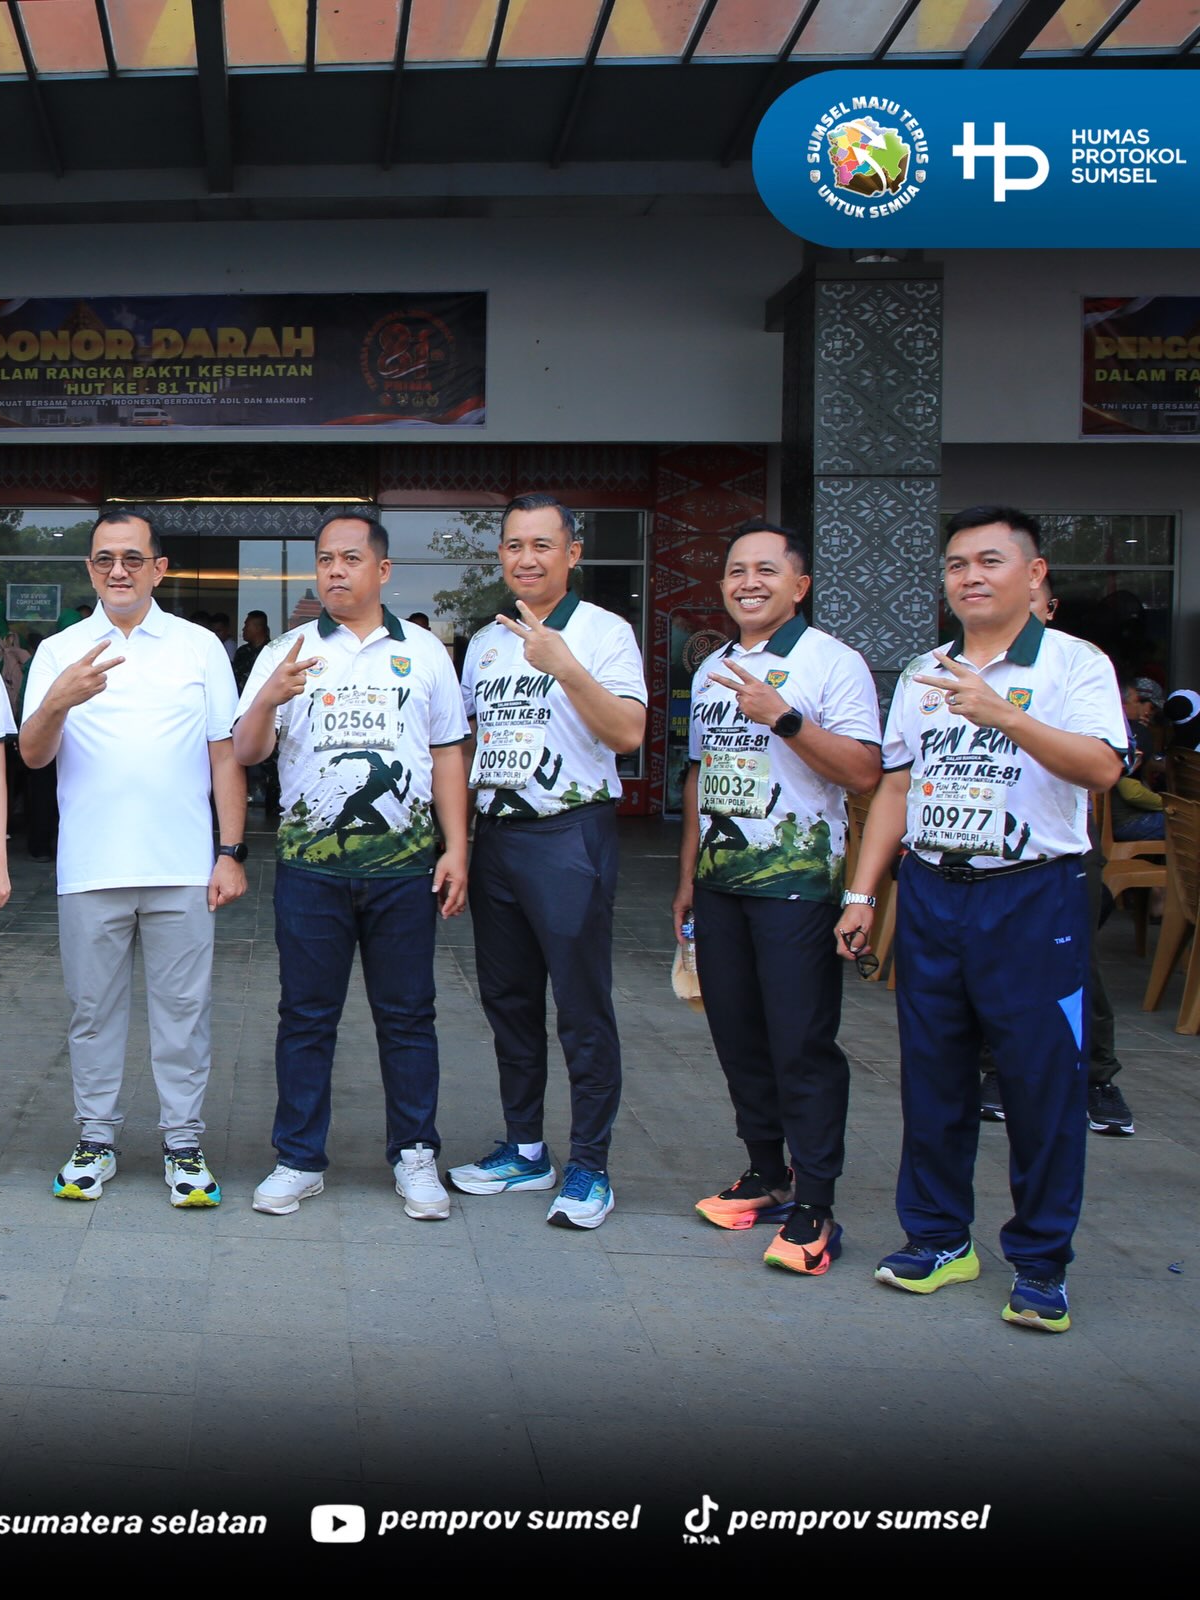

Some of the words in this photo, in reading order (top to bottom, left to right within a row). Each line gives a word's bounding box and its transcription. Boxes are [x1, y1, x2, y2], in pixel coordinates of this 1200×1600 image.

[152, 326, 316, 360] DARAH
[46, 367, 125, 380] RANGKA
[133, 366, 191, 379] BAKTI
[198, 364, 313, 378] KESEHATAN
[1095, 368, 1167, 382] DALAM
[112, 383, 138, 394] KE
[157, 382, 179, 394] 81
[1151, 402, 1200, 410] BERSAMA
[475, 675, 512, 704] FUN
[514, 674, 556, 699] RUN
[324, 710, 386, 732] 02564
[497, 709, 516, 721] TNI
[519, 708, 551, 720] KE-81
[693, 701, 731, 726] FUN
[713, 735, 734, 747] TNI
[735, 734, 770, 747] KE-81
[920, 725, 967, 762] FUN
[968, 727, 1019, 756] RUN
[480, 750, 532, 770] 00980
[943, 763, 971, 777] TNI
[974, 764, 1022, 782] KE-81
[704, 774, 756, 798] 00032
[935, 782, 950, 791] FUN
[951, 781, 969, 791] RUN
[922, 804, 993, 831] 00977
[928, 830, 938, 838] 5K
[940, 831, 980, 842] TNI/POLRI
